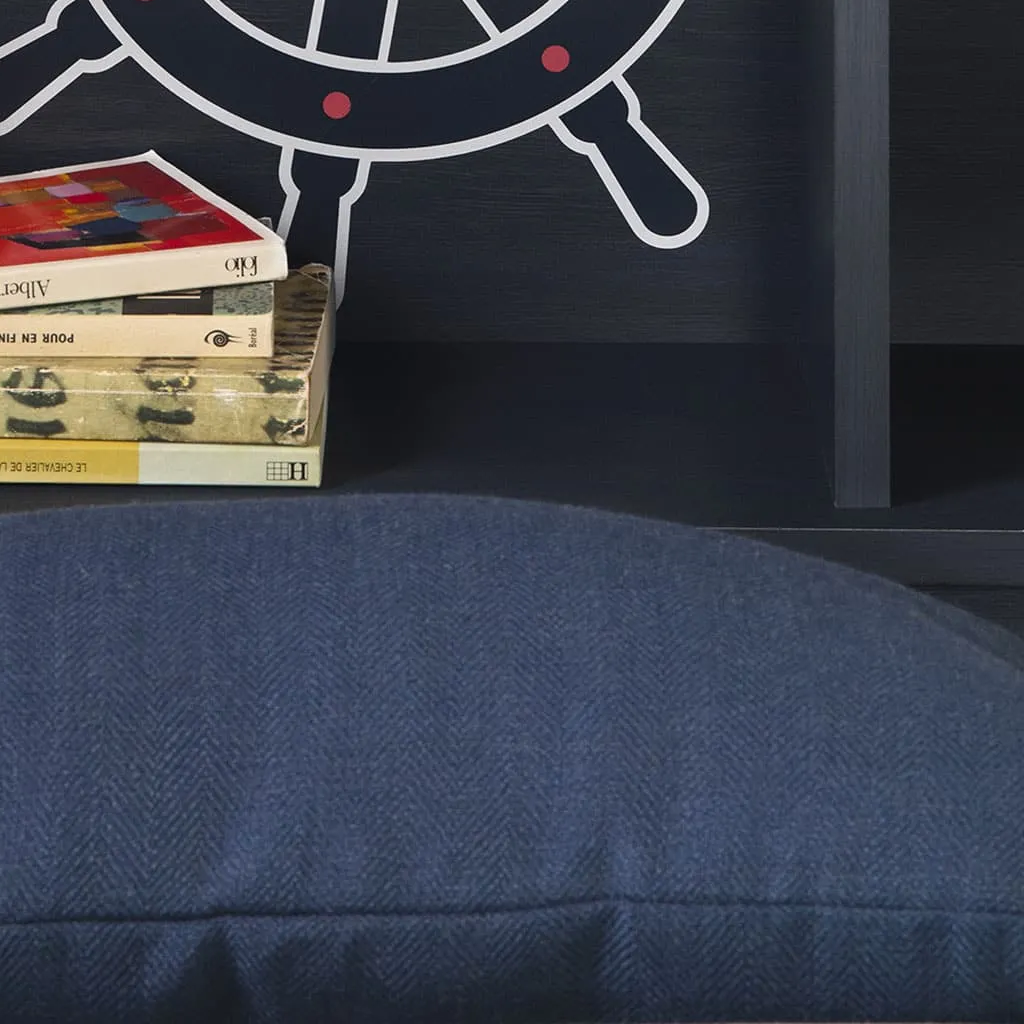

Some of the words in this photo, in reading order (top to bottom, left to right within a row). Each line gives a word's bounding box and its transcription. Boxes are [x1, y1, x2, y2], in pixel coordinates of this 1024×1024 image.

[225, 255, 258, 278] folio
[21, 332, 37, 344] EN
[42, 332, 75, 344] POUR
[9, 461, 23, 472] DE
[25, 461, 74, 472] CHEVALIER
[75, 462, 87, 472] LE
